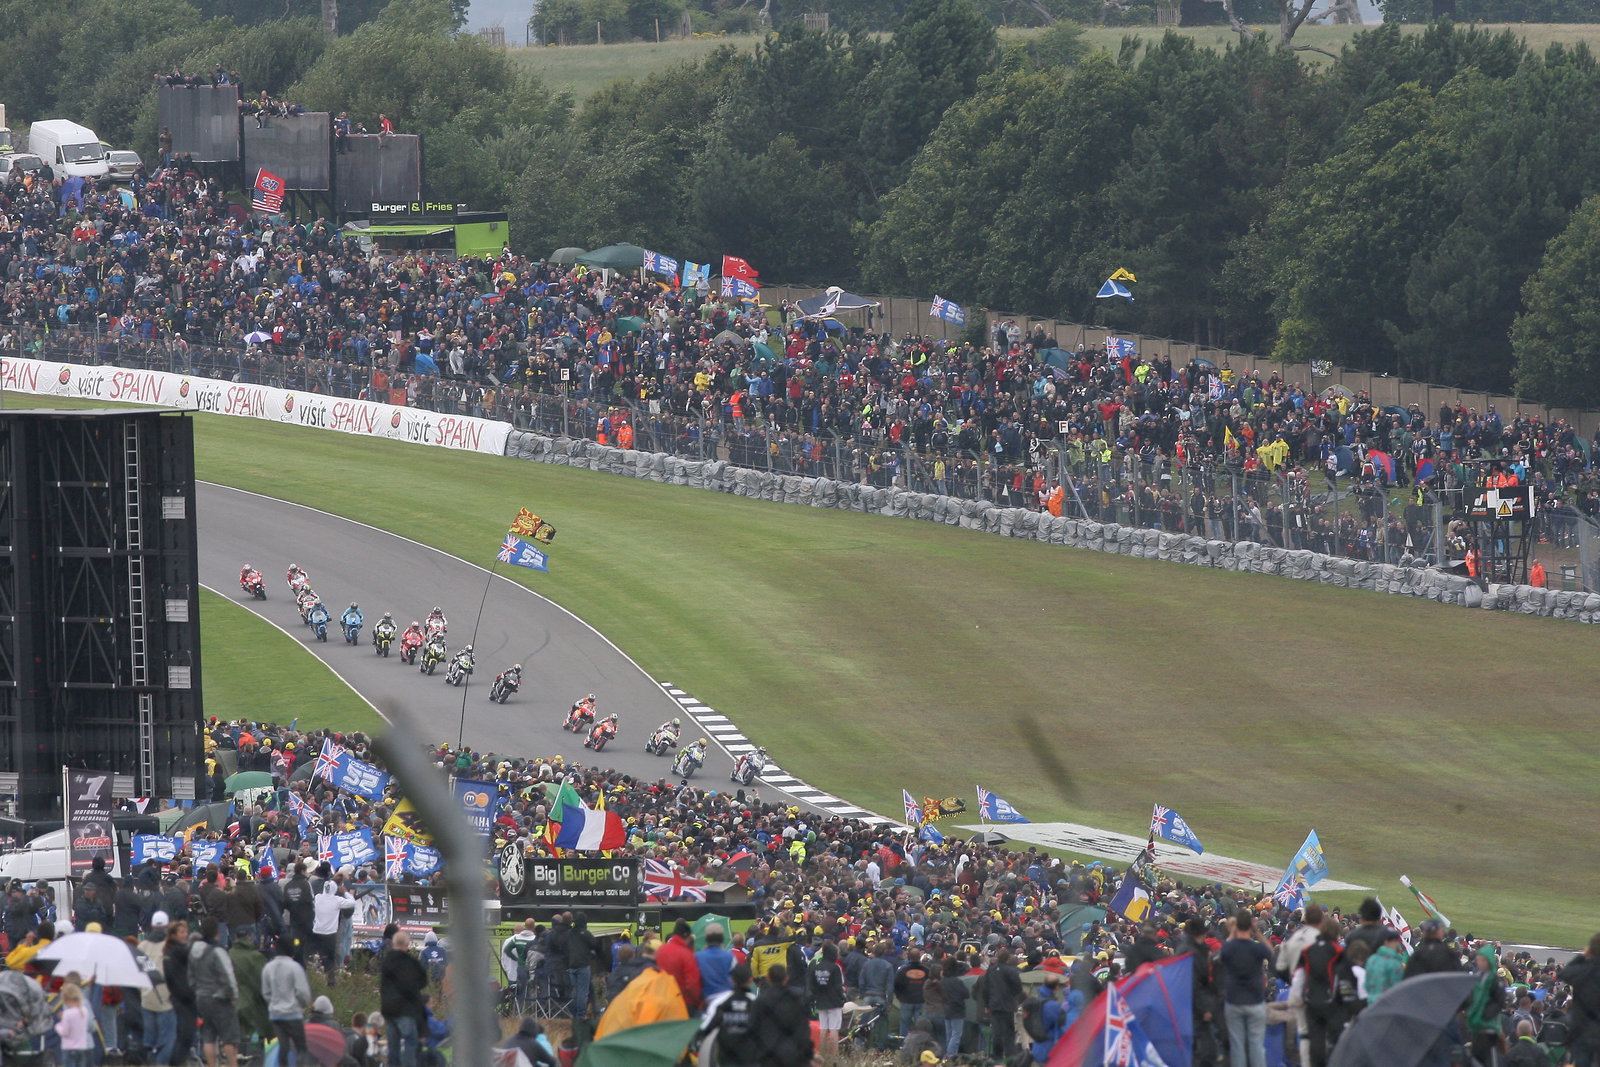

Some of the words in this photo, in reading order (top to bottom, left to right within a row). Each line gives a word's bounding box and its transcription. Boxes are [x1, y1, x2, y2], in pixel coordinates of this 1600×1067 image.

[371, 203, 407, 214] Burger
[411, 203, 420, 212] &
[426, 202, 453, 211] Fries
[561, 369, 568, 379] F
[78, 371, 104, 397] visit
[110, 371, 165, 403] SPAIN
[195, 384, 222, 412] visit
[224, 385, 268, 417] SPAIN
[300, 399, 326, 428] visit
[330, 401, 377, 434] SPAIN
[1060, 422, 1067, 431] F
[407, 414, 431, 443] visit
[435, 417, 484, 450] SPAIN
[1465, 505, 1469, 514] 7
[518, 548, 543, 568] 52
[342, 764, 380, 794] 52
[140, 841, 177, 864] 52
[337, 838, 375, 864] 52
[534, 865, 557, 885] Big
[563, 865, 611, 885] Burger
[562, 889, 578, 897] Burger
